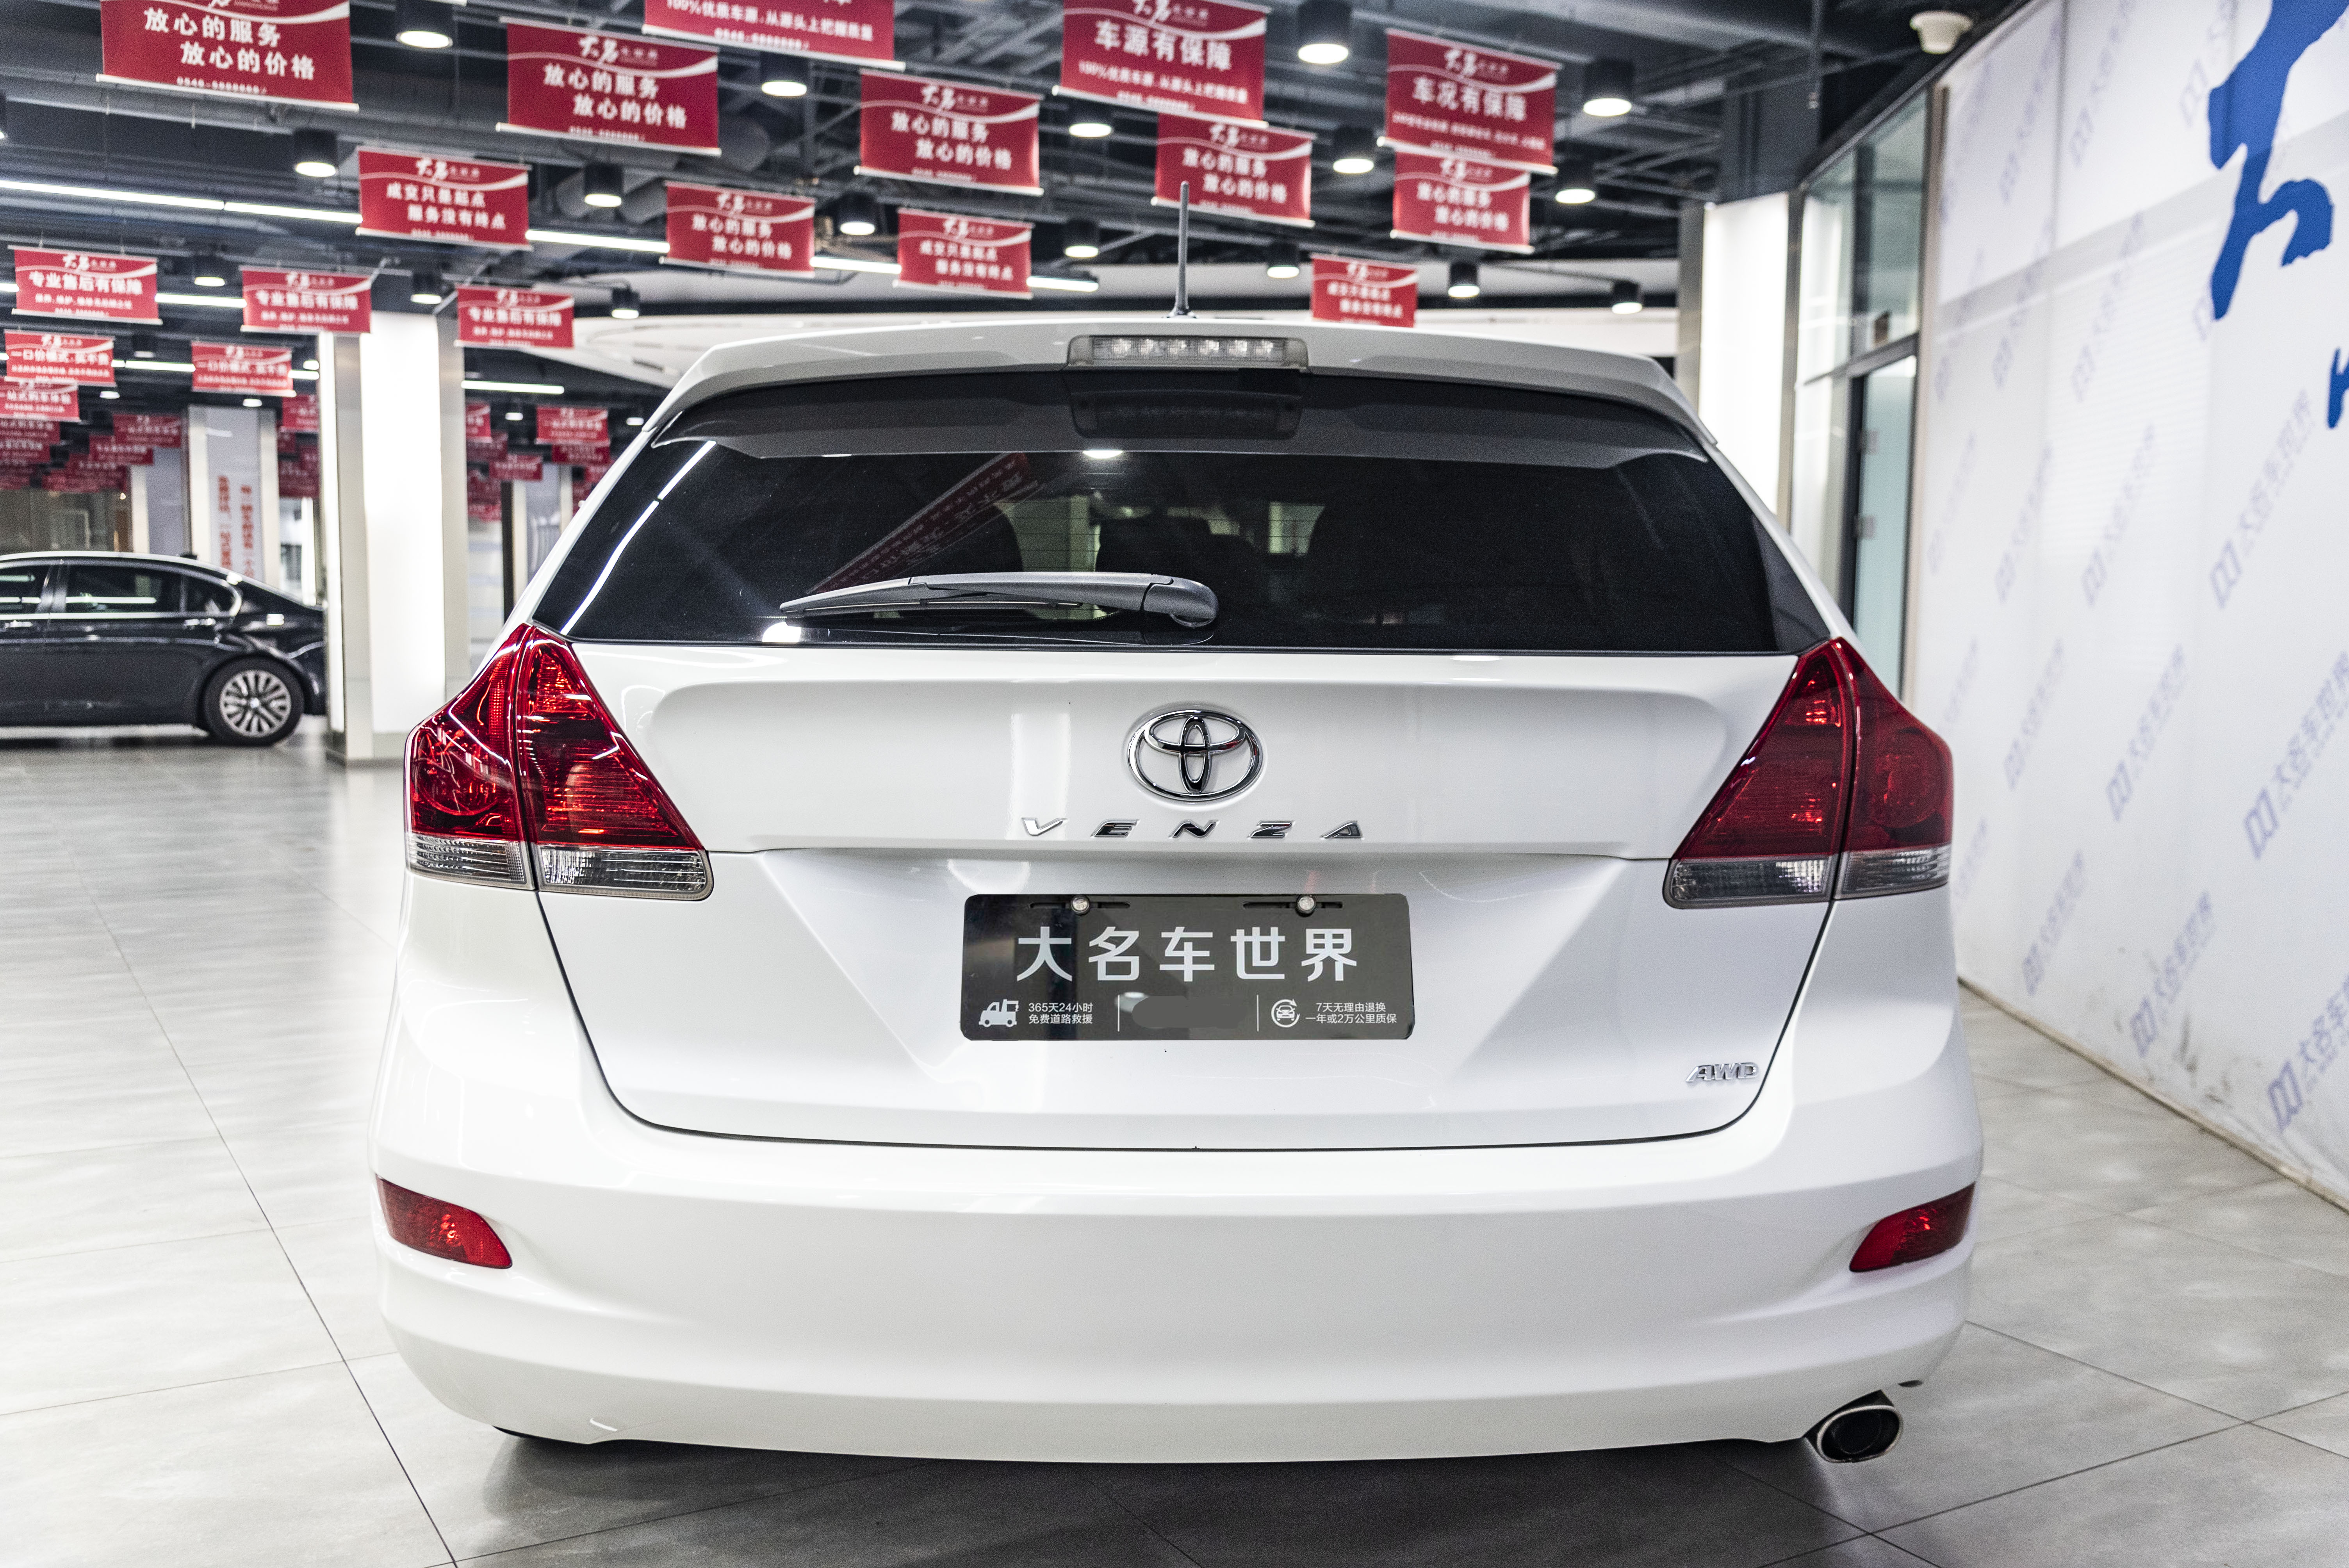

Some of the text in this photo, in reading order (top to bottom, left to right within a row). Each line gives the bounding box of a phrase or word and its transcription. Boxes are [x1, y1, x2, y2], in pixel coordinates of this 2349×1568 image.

[144, 7, 281, 47] 放心的服务
[1094, 19, 1232, 71] 车源有保障
[180, 41, 315, 80] 放心的价格
[544, 63, 659, 100] 放心的服务
[573, 93, 687, 130] 放心的价格
[1021, 817, 1364, 839] VENZA
[1017, 927, 1356, 982] 大名车世界
[1028, 1002, 1094, 1013] 365天24小时
[1028, 1014, 1093, 1024] 免费道路救援
[1305, 1014, 1397, 1024] 一年或2万公里质保
[1315, 1002, 1386, 1013] 7天无理由退换
[1685, 1062, 1758, 1082] AWD
